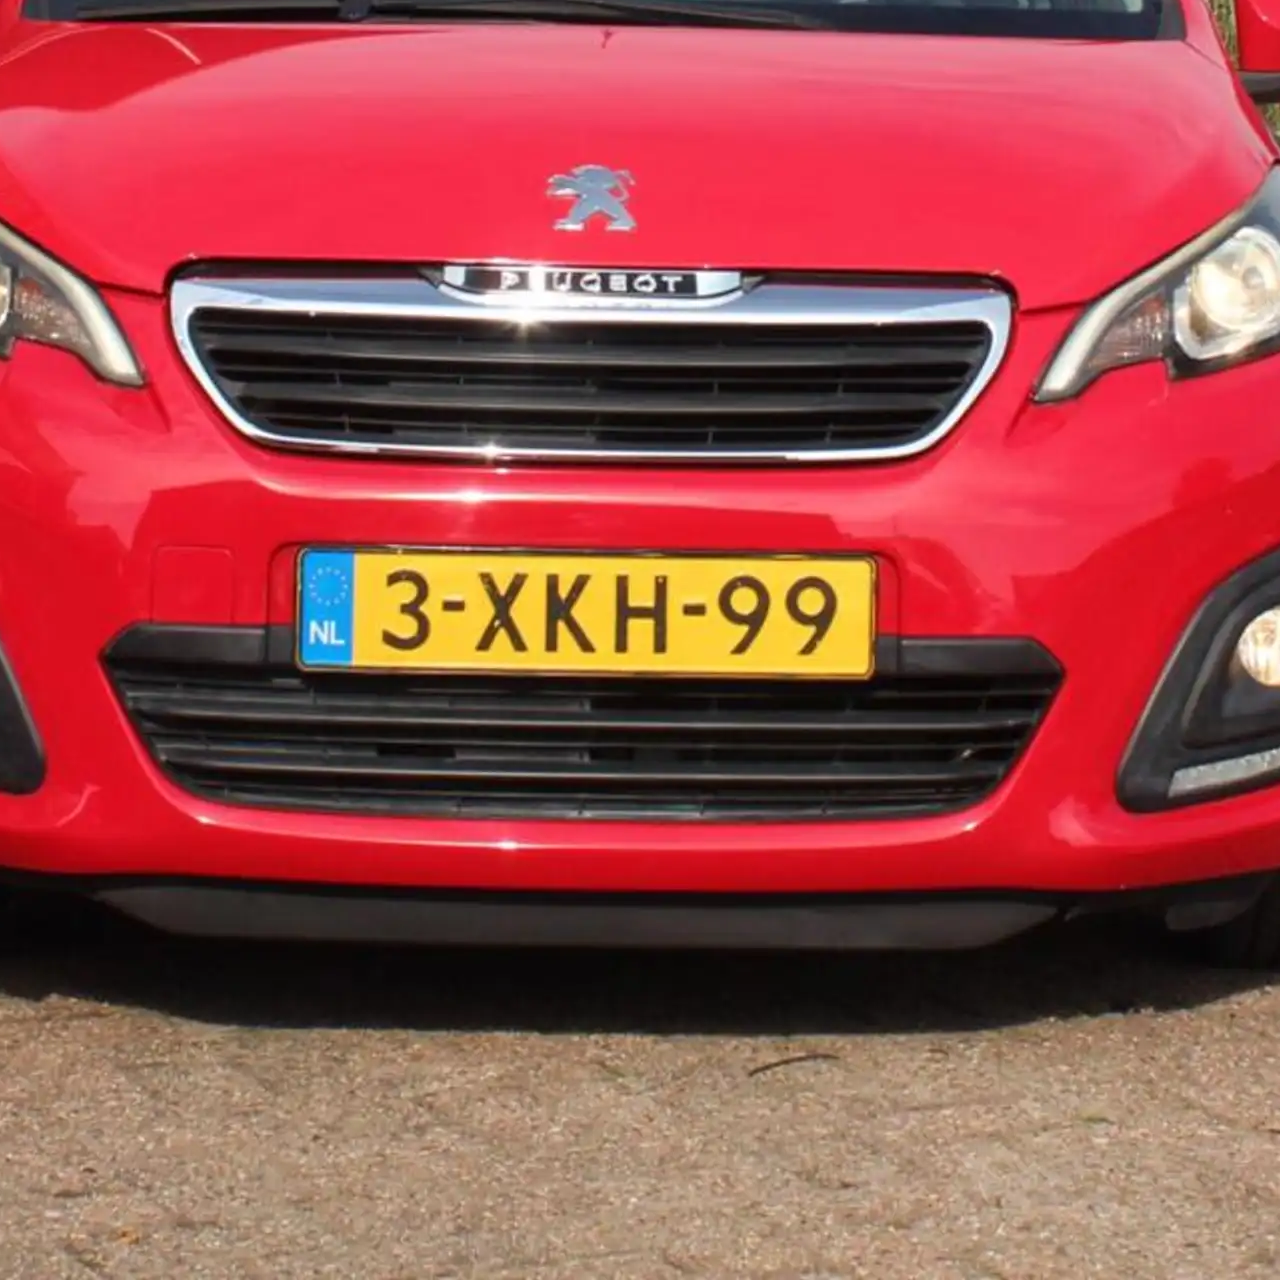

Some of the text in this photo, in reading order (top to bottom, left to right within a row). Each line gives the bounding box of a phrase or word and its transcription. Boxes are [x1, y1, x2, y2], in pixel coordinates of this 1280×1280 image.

[499, 271, 684, 293] PUGEOT
[380, 569, 839, 656] 3-XKH-99
[309, 621, 345, 646] NL
